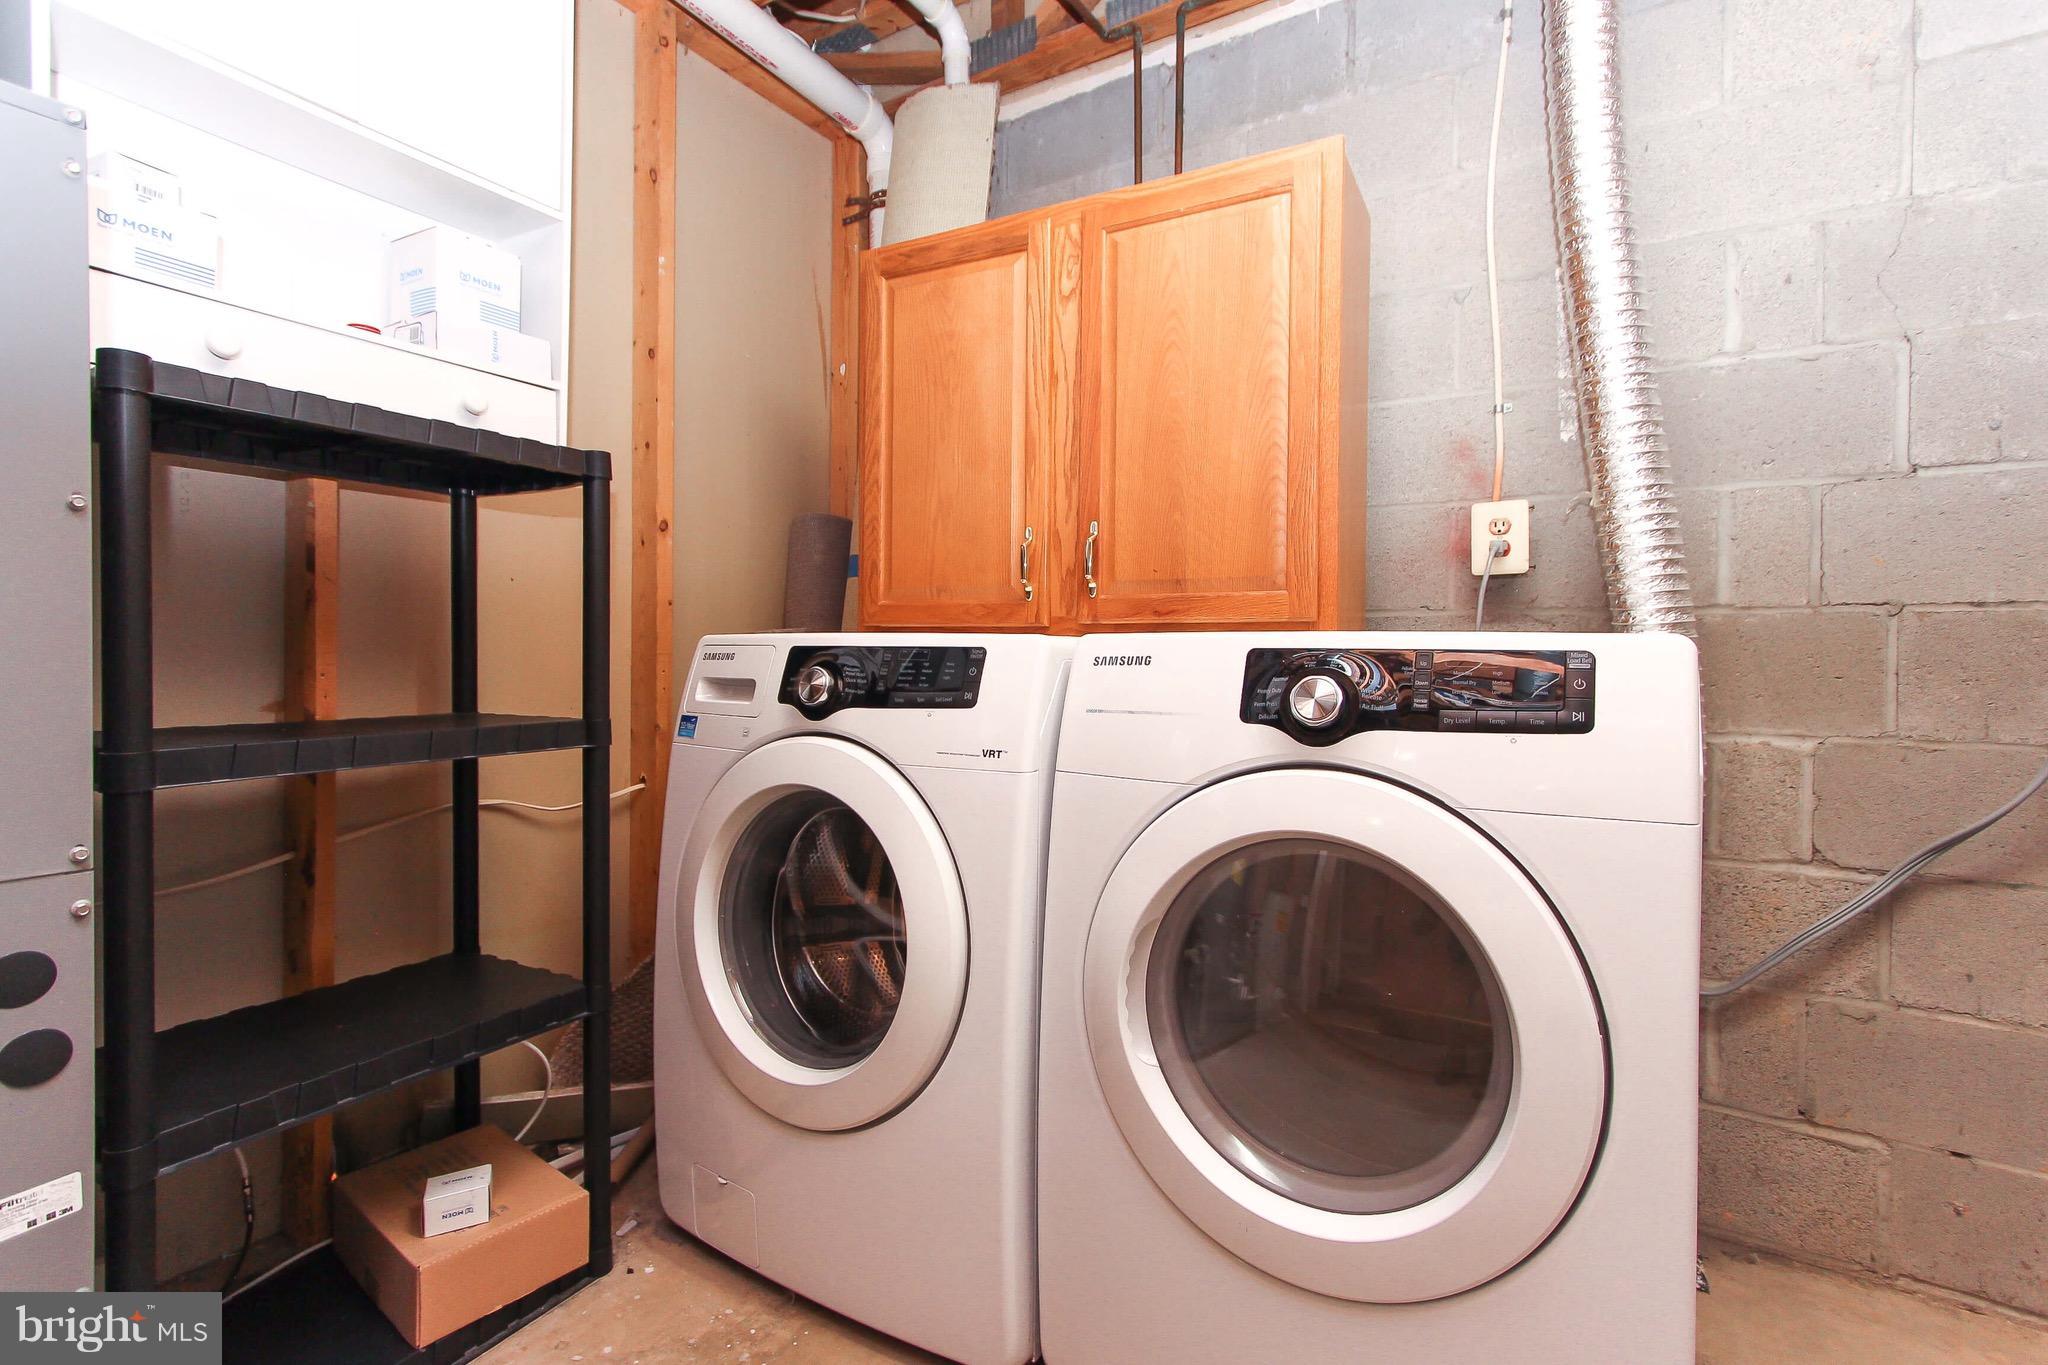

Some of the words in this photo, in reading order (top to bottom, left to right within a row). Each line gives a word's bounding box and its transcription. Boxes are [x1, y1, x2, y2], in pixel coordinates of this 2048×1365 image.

[122, 218, 173, 241] MOEN
[472, 276, 501, 292] MOEN
[702, 652, 736, 661] SAMSUNG
[1092, 655, 1153, 667] SAMSUNG
[1443, 717, 1454, 725] Dry
[58, 1205, 74, 1216] 3M
[441, 1209, 464, 1220] MOEN
